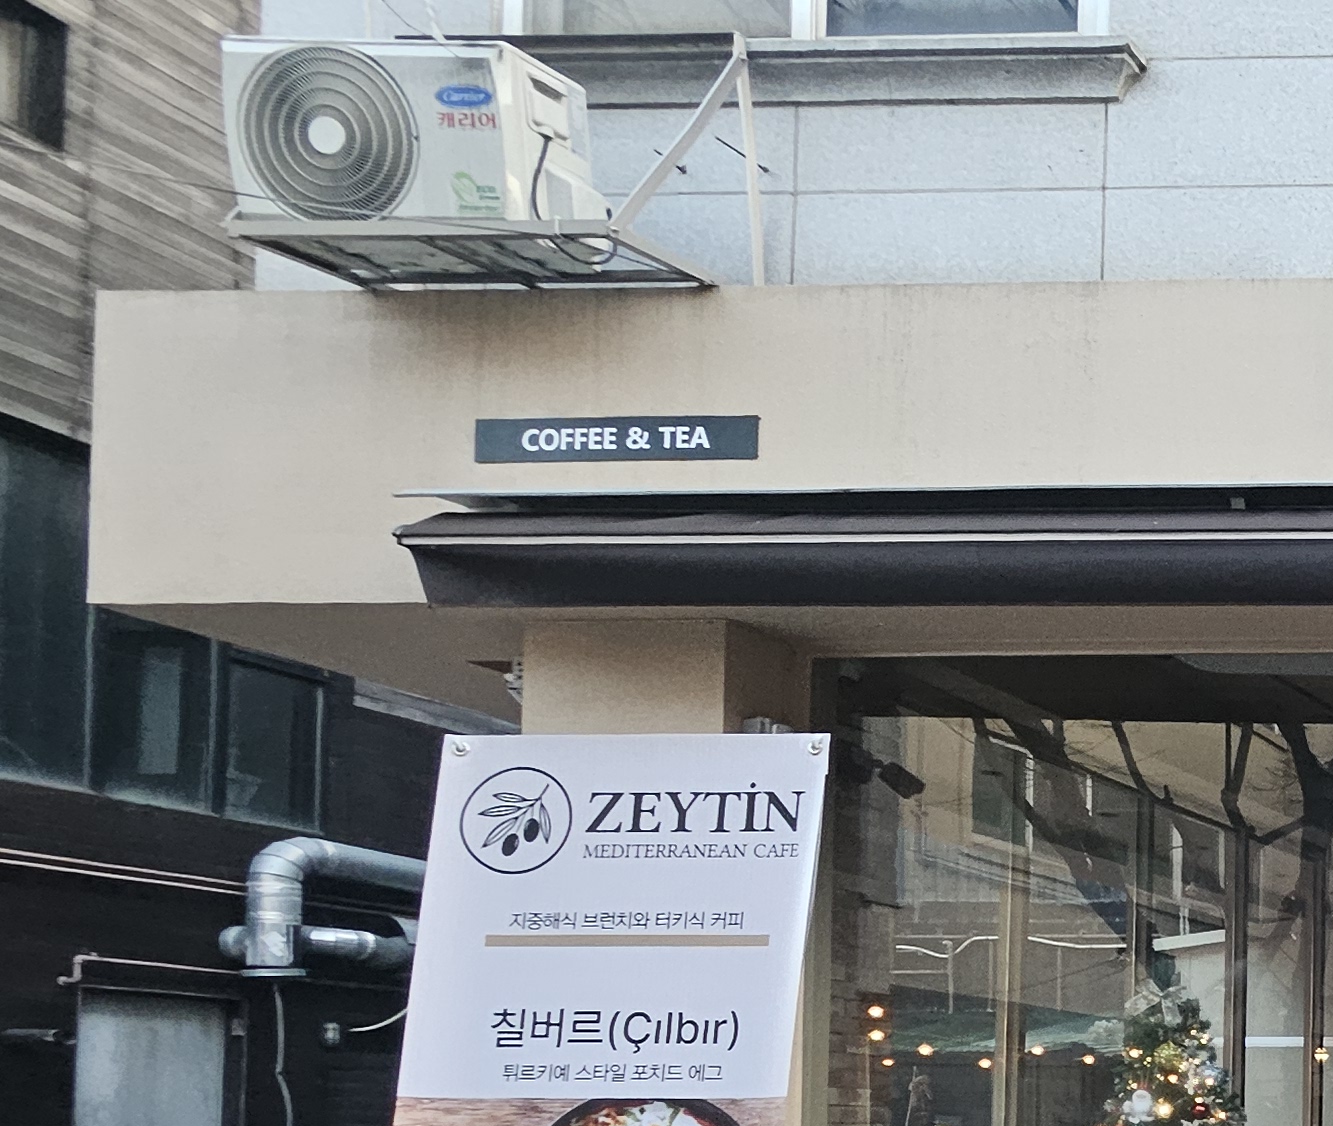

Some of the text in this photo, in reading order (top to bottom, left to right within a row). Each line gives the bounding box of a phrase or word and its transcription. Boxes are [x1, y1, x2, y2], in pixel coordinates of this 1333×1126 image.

[436, 112, 497, 129] 캐리어
[521, 427, 711, 452] COFFEE & TEA
[582, 843, 800, 859] MEDITERRANEAN CAFE
[509, 911, 745, 931] 지중해식 브런치와 터키식 커피
[502, 1063, 723, 1083] 튀르키예 스타일 포치드 에그
